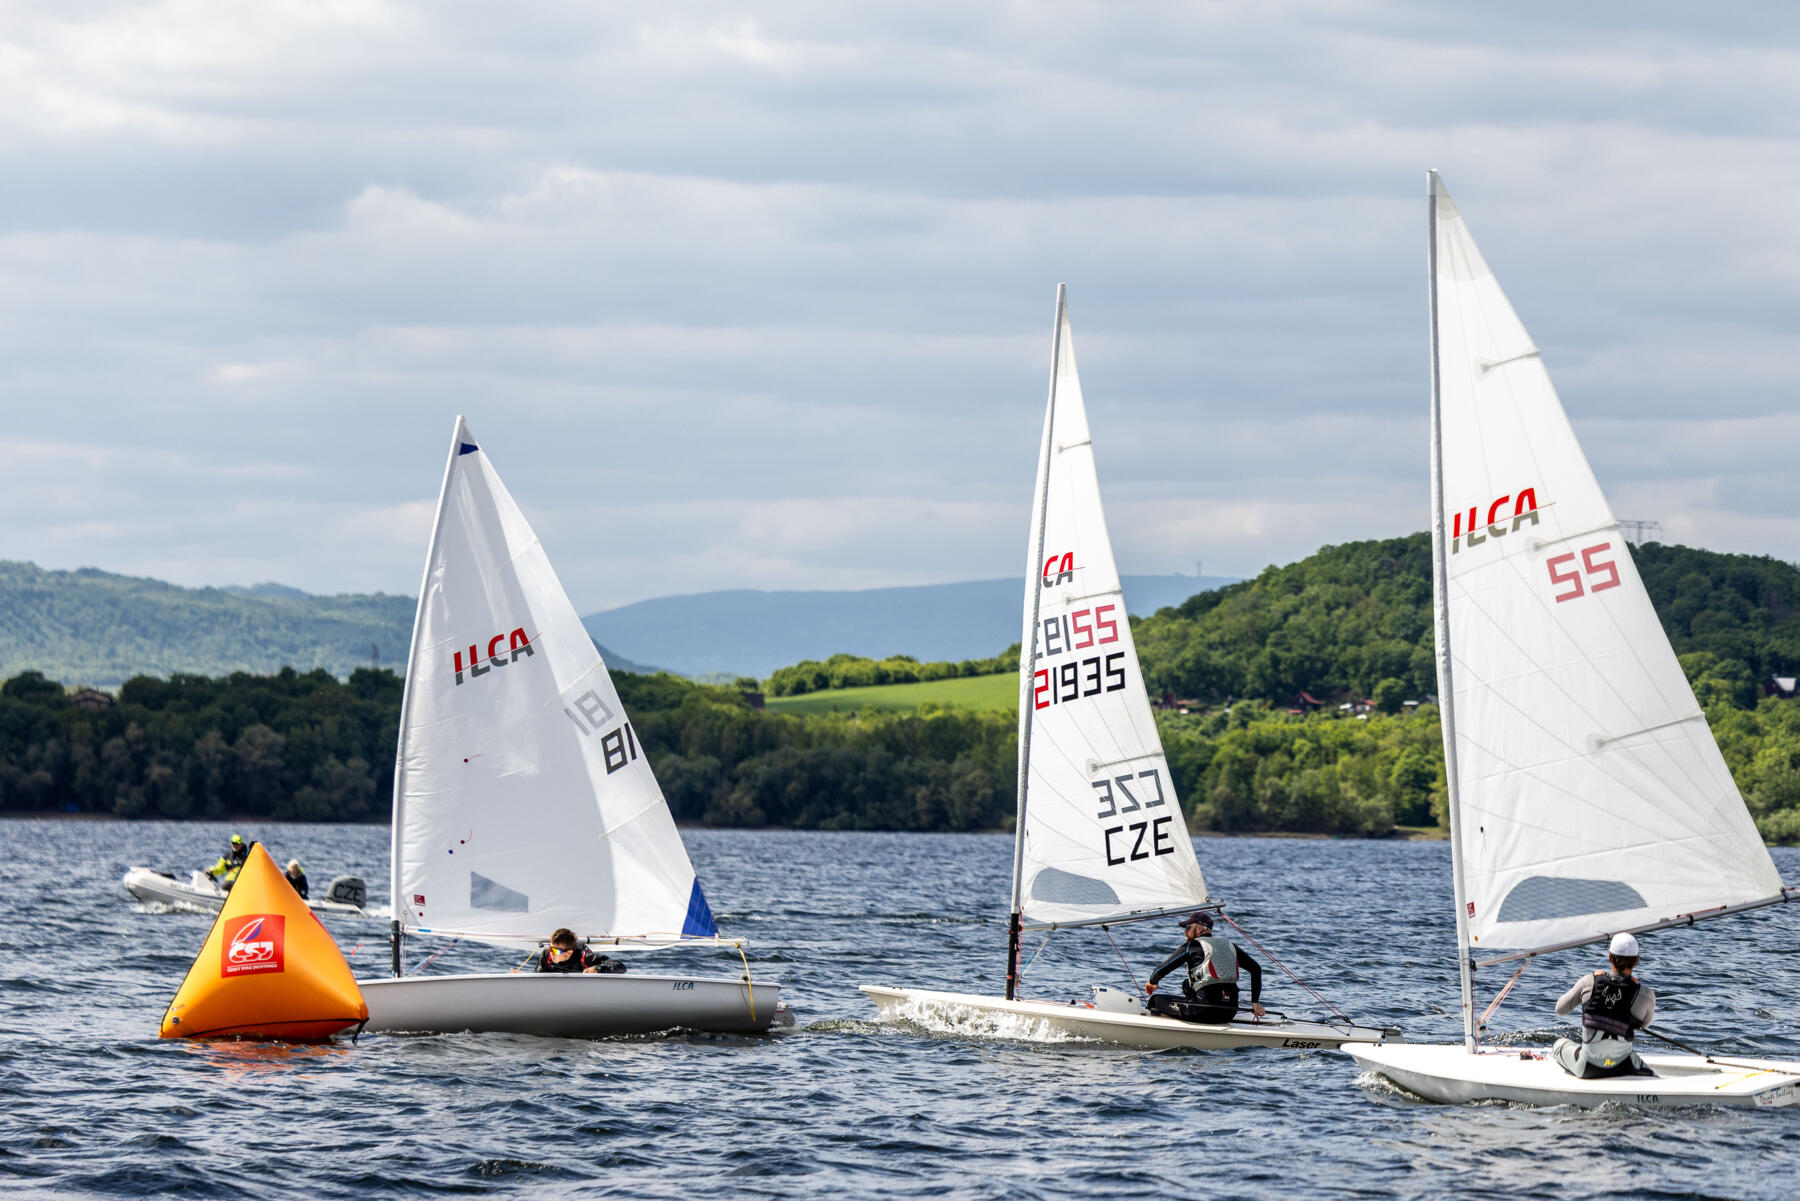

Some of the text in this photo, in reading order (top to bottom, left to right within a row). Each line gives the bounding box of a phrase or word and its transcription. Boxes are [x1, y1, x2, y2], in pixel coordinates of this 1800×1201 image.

[1452, 487, 1540, 555] ILCA
[453, 627, 535, 686] ILCA
[601, 722, 637, 775] 81
[1105, 816, 1174, 866] CZE
[333, 883, 364, 902] CZE
[672, 981, 694, 991] ILCA
[1282, 1038, 1321, 1049] Laser
[1637, 1094, 1659, 1104] ILCA
